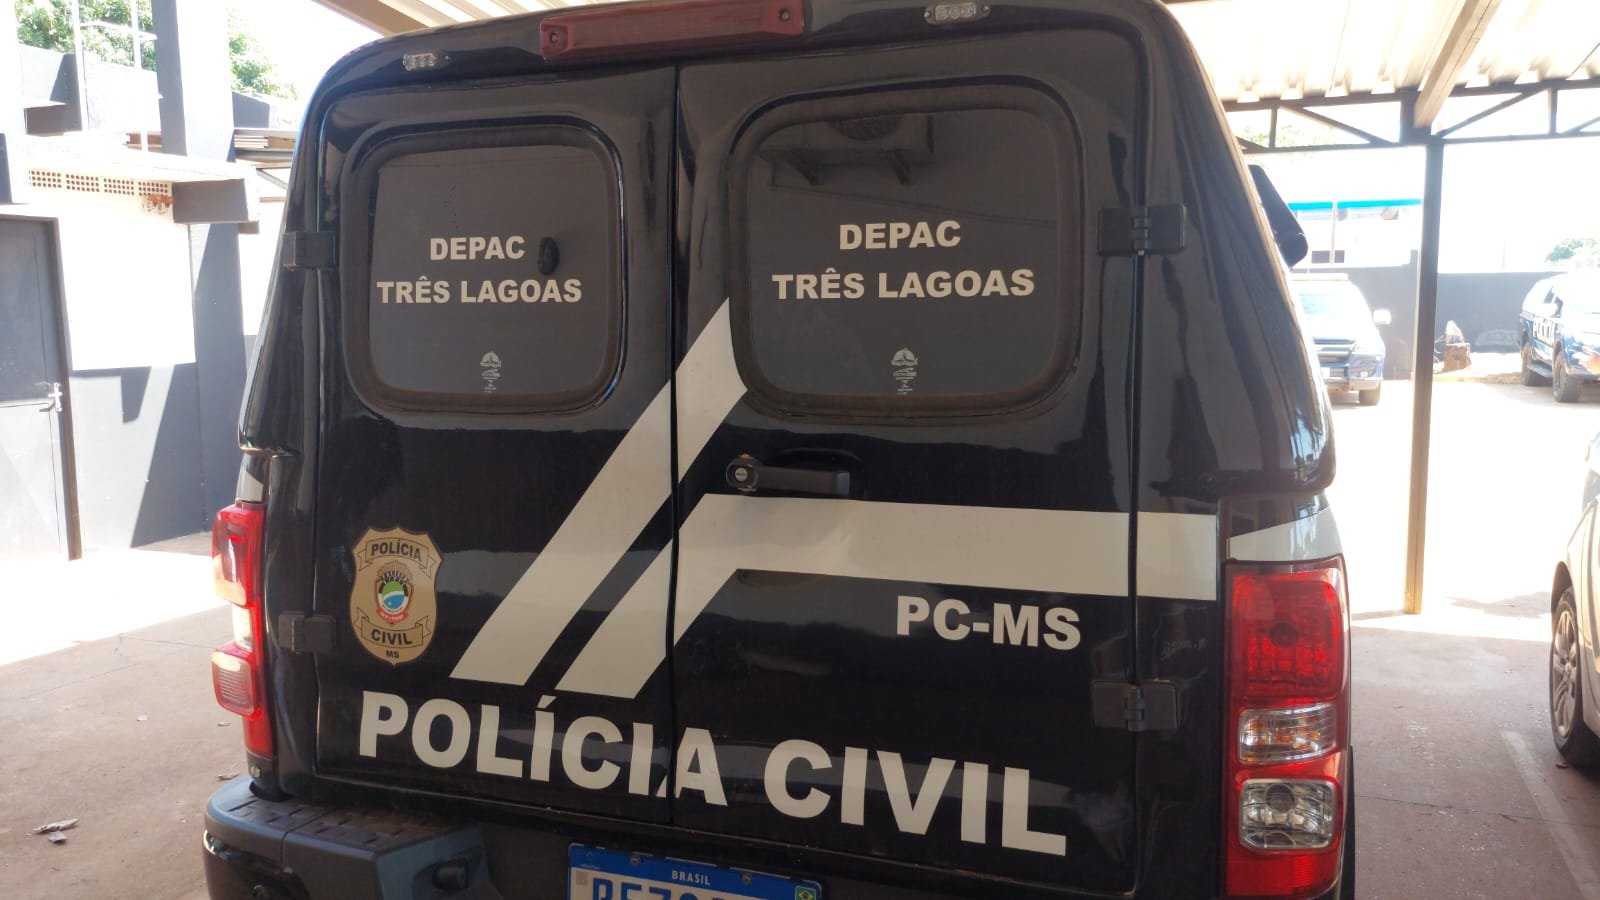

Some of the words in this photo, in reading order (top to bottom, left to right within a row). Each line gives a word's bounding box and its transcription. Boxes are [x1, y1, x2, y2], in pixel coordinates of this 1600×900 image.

[430, 235, 525, 261] DEPAC
[839, 220, 961, 250] DEPAC
[376, 275, 451, 304] TRÊS
[460, 278, 582, 303] LAGOAS
[771, 267, 865, 300] TRÊS
[878, 268, 1035, 299] LAGOAS
[371, 539, 422, 562] POLÍCIA
[896, 595, 1081, 651] PC-MS
[371, 628, 413, 646] CIVIL
[385, 650, 400, 659] MS
[359, 690, 728, 806] POLÍCIA
[763, 739, 1067, 857] CIVIL
[671, 869, 711, 886] BRASIL
